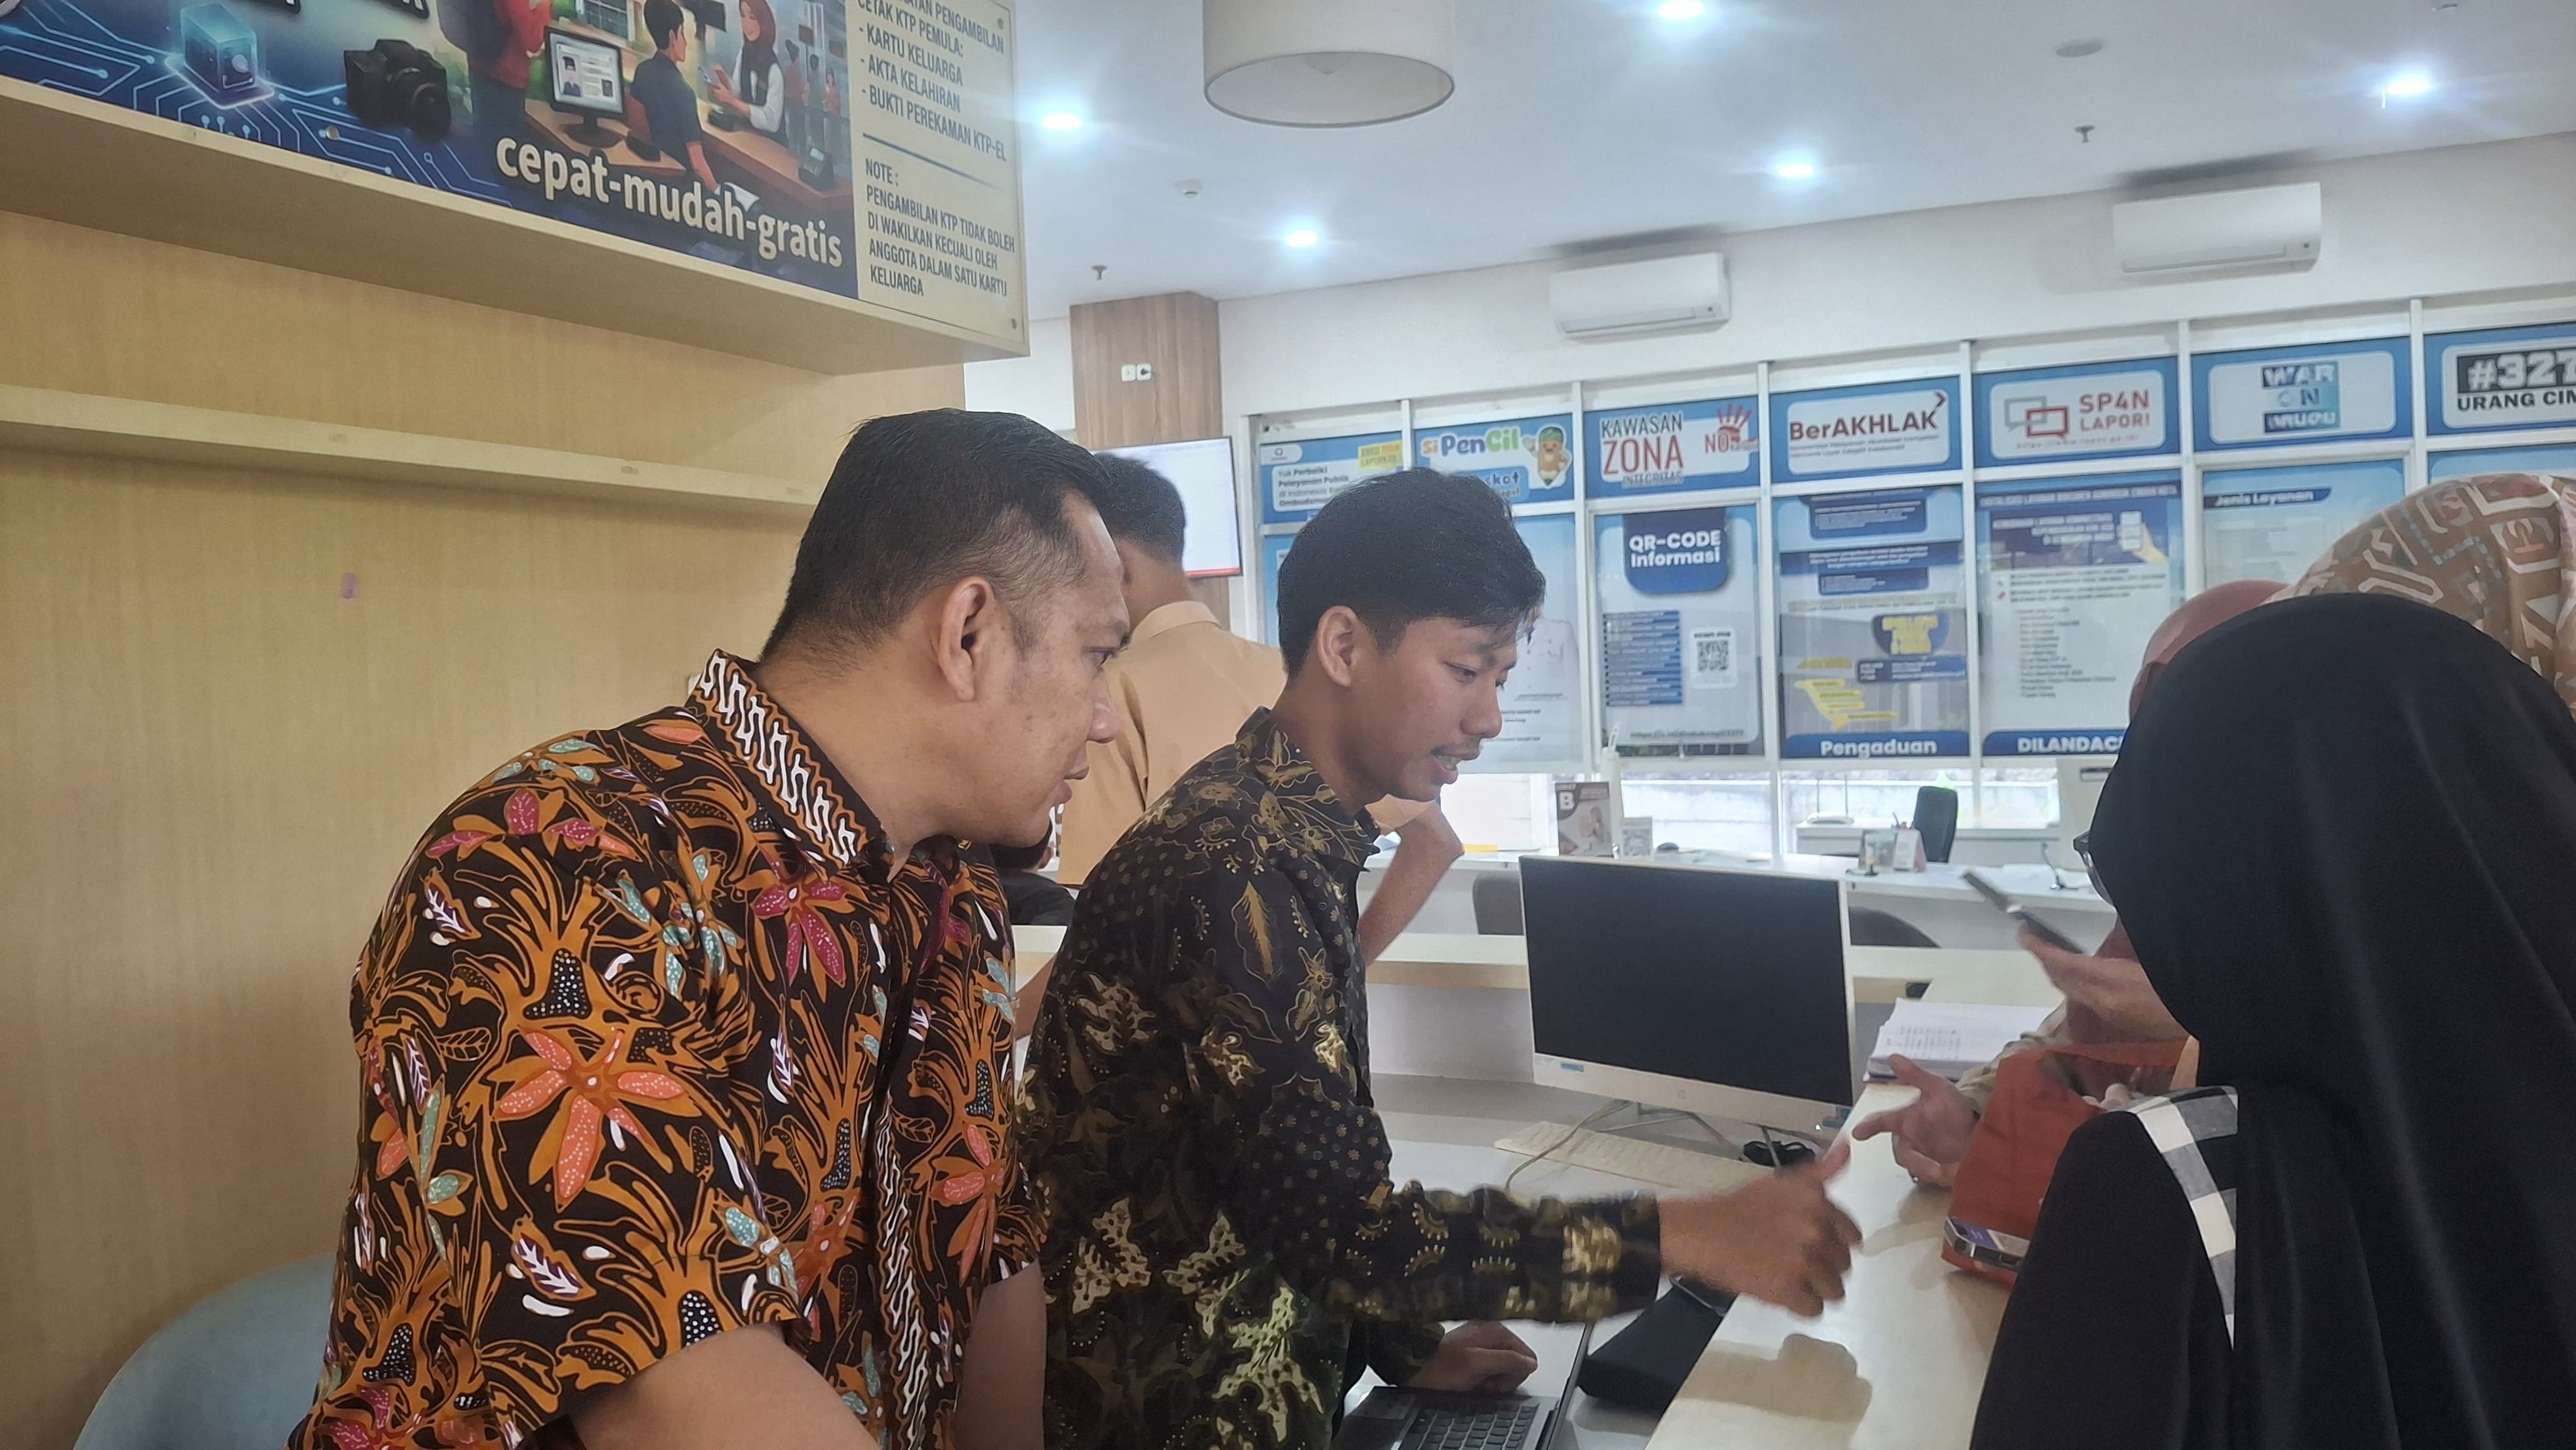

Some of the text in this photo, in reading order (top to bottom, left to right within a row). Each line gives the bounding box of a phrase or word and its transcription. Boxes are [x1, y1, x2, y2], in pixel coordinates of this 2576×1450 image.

[896, 8, 916, 32] KTP
[919, 18, 964, 57] PEMULA:
[936, 3, 1004, 54] PENGAMBILAN
[867, 23, 905, 58] KARTU
[908, 42, 963, 86] KELUARGA
[868, 54, 898, 85] AKTA
[901, 69, 960, 113] KELAHIRAN
[869, 85, 903, 117] BUKTI
[907, 101, 971, 148] PEREKAMAN
[974, 129, 1006, 161] KTP-EL
[496, 136, 843, 268] cepat-mudah-gratis
[867, 185, 1015, 253] PENGAMBILAN KTP TIDAK BOLEH
[868, 211, 997, 270] DI WAKILKAN KECUALI OLEH
[869, 239, 1007, 297] ANGGOTA DALAM SATU KARTU
[870, 264, 924, 296] KELUARGA
[2079, 389, 2150, 414] SP4N
[2458, 393, 2535, 410] URANG
[1602, 414, 1682, 438] KAWASAN
[1789, 410, 1938, 440] BerAKHLAK
[2080, 414, 2150, 432] LAPOR!
[1603, 433, 1729, 475] ZONA NO
[1629, 530, 1721, 553] QR-CODE
[1631, 547, 1720, 568] Informasi
[1820, 738, 1938, 758] Pengaduan
[2017, 735, 2123, 753] DILANDAC
[1559, 792, 1575, 810] B
